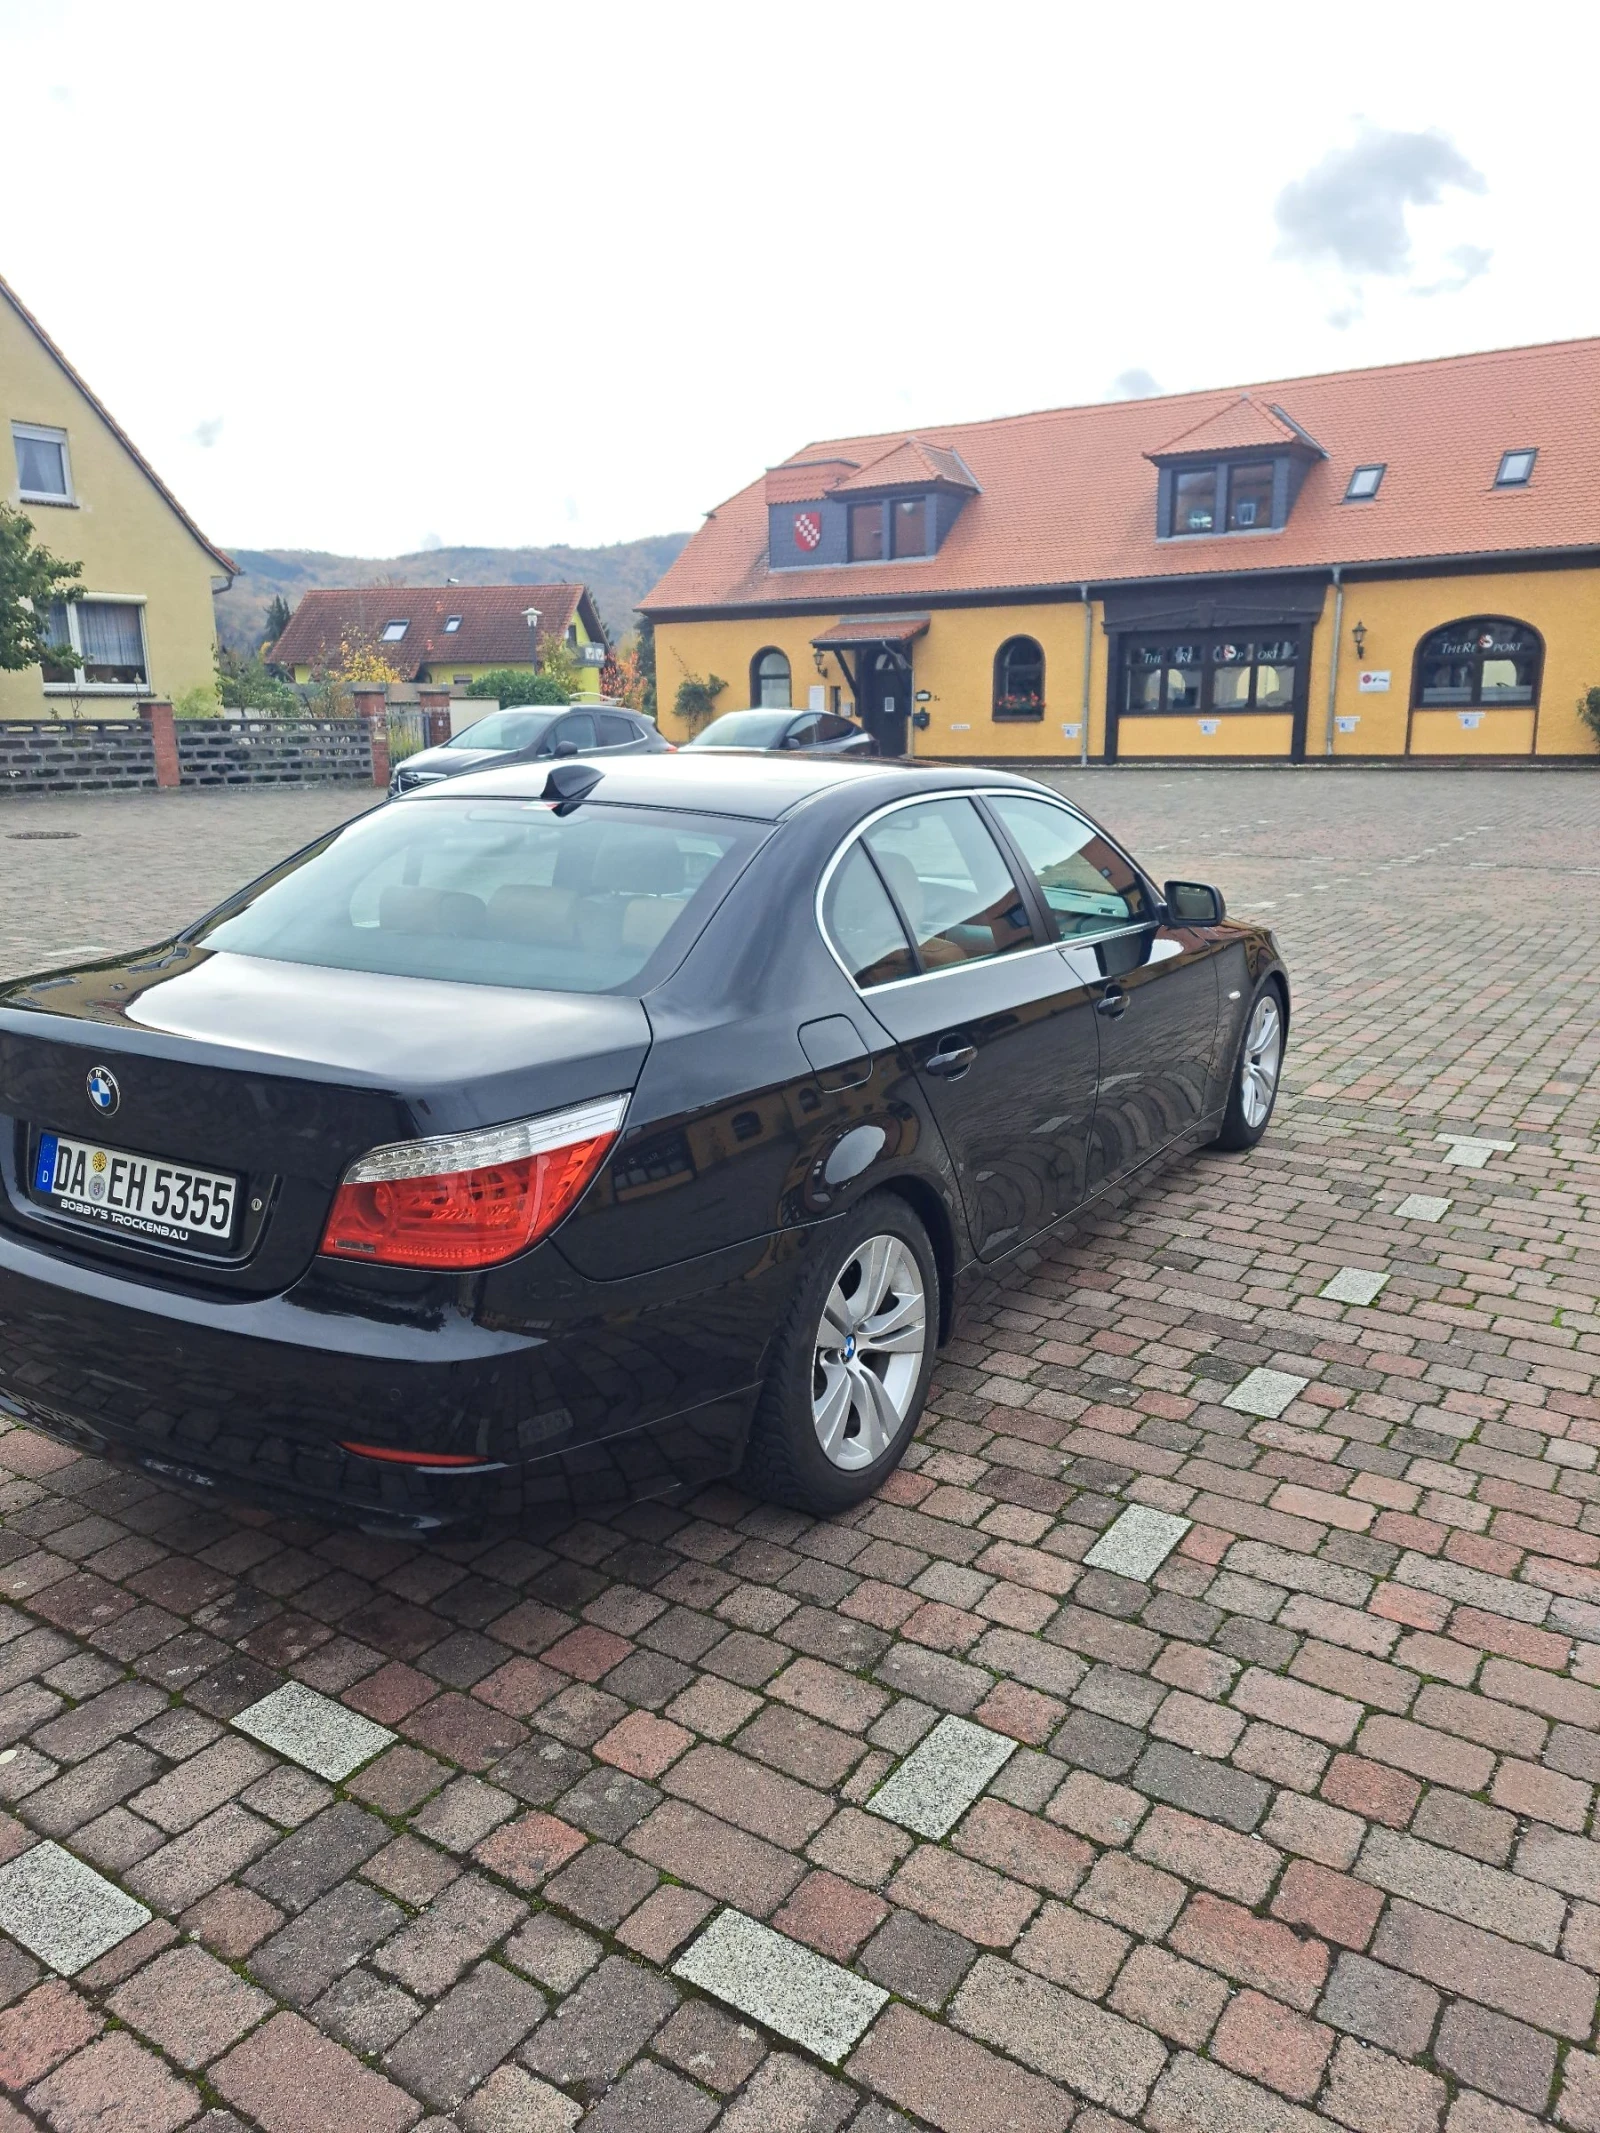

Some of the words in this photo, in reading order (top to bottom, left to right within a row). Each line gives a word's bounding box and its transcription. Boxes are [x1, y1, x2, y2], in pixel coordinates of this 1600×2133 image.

[87, 1069, 113, 1087] BMW
[42, 1170, 48, 1183] D
[54, 1145, 86, 1197] DA
[152, 1169, 232, 1230] 5355
[60, 1198, 108, 1219] BOBBY'S
[110, 1212, 189, 1241] TROCKENBAU
